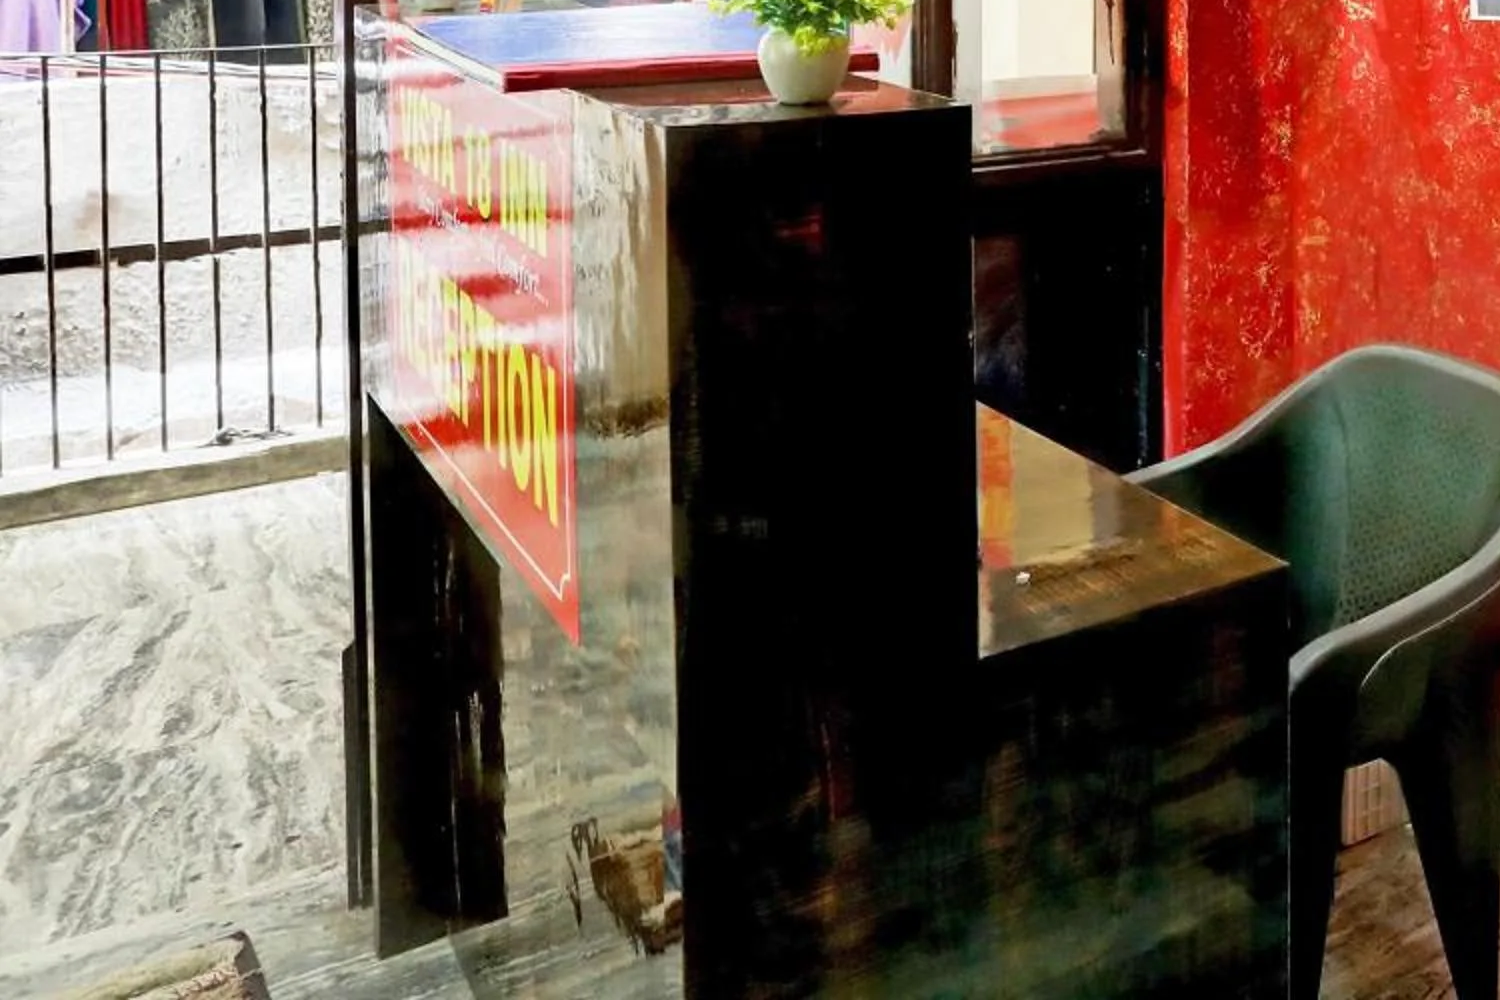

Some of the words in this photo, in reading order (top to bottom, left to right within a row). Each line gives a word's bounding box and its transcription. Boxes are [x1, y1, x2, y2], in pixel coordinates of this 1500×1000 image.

[400, 85, 458, 195] VISTA
[500, 138, 548, 259] INN
[398, 236, 559, 529] RECEPTION
